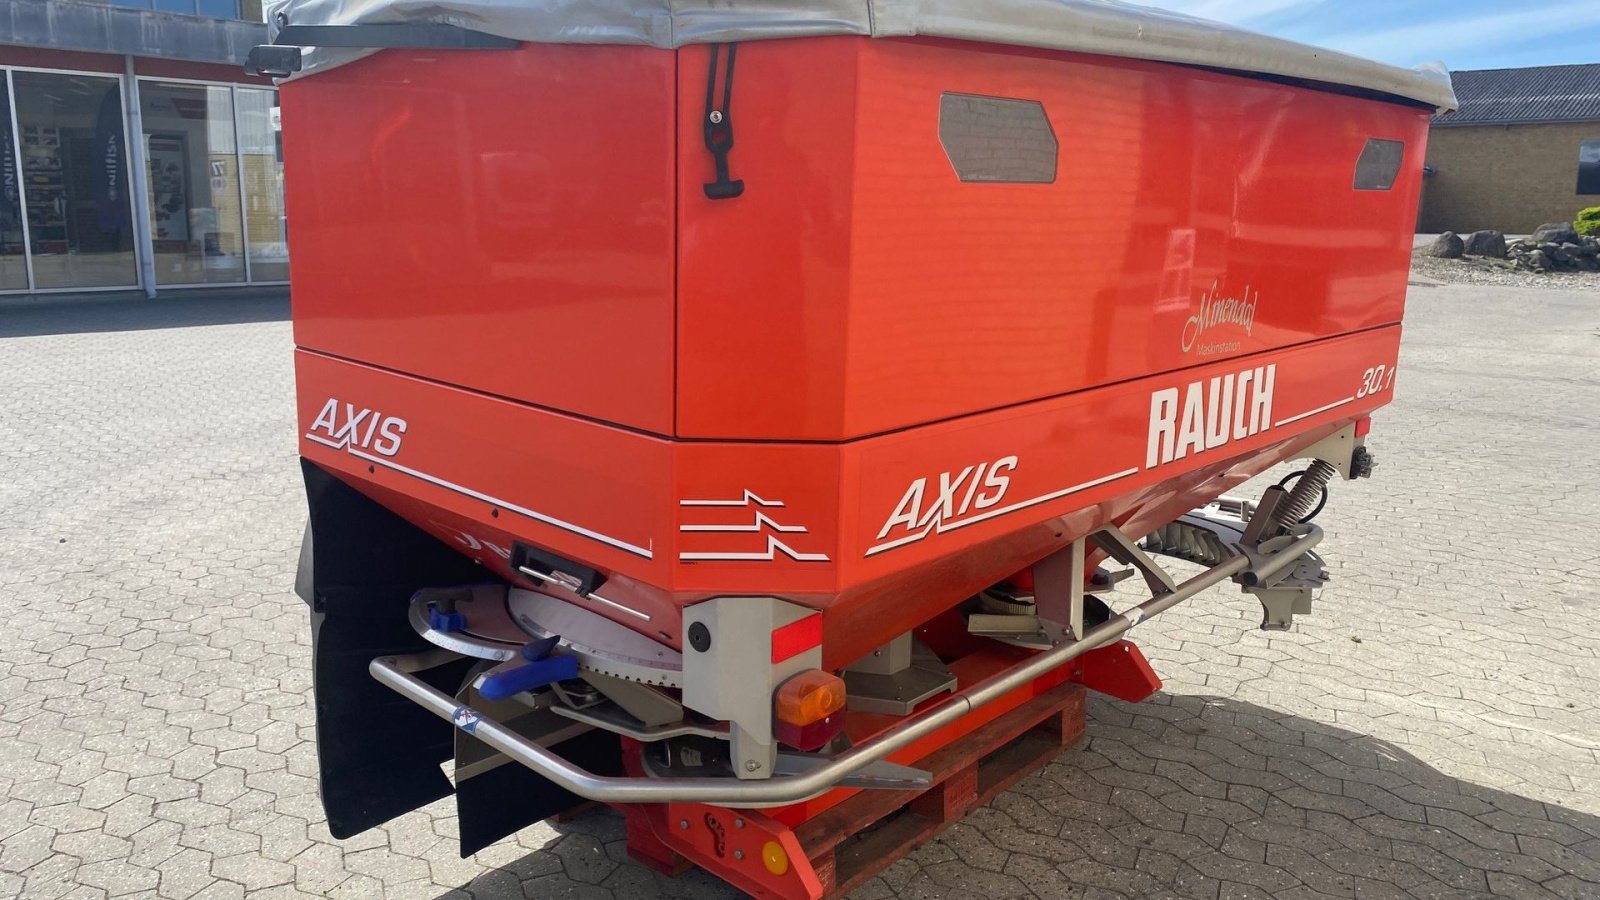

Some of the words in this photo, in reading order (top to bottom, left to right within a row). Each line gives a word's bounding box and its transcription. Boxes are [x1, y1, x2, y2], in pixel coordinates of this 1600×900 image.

[1146, 364, 1276, 469] RAUCH
[1356, 364, 1395, 399] 30.1
[311, 398, 407, 456] AXIS
[876, 455, 1018, 540] AXIS
